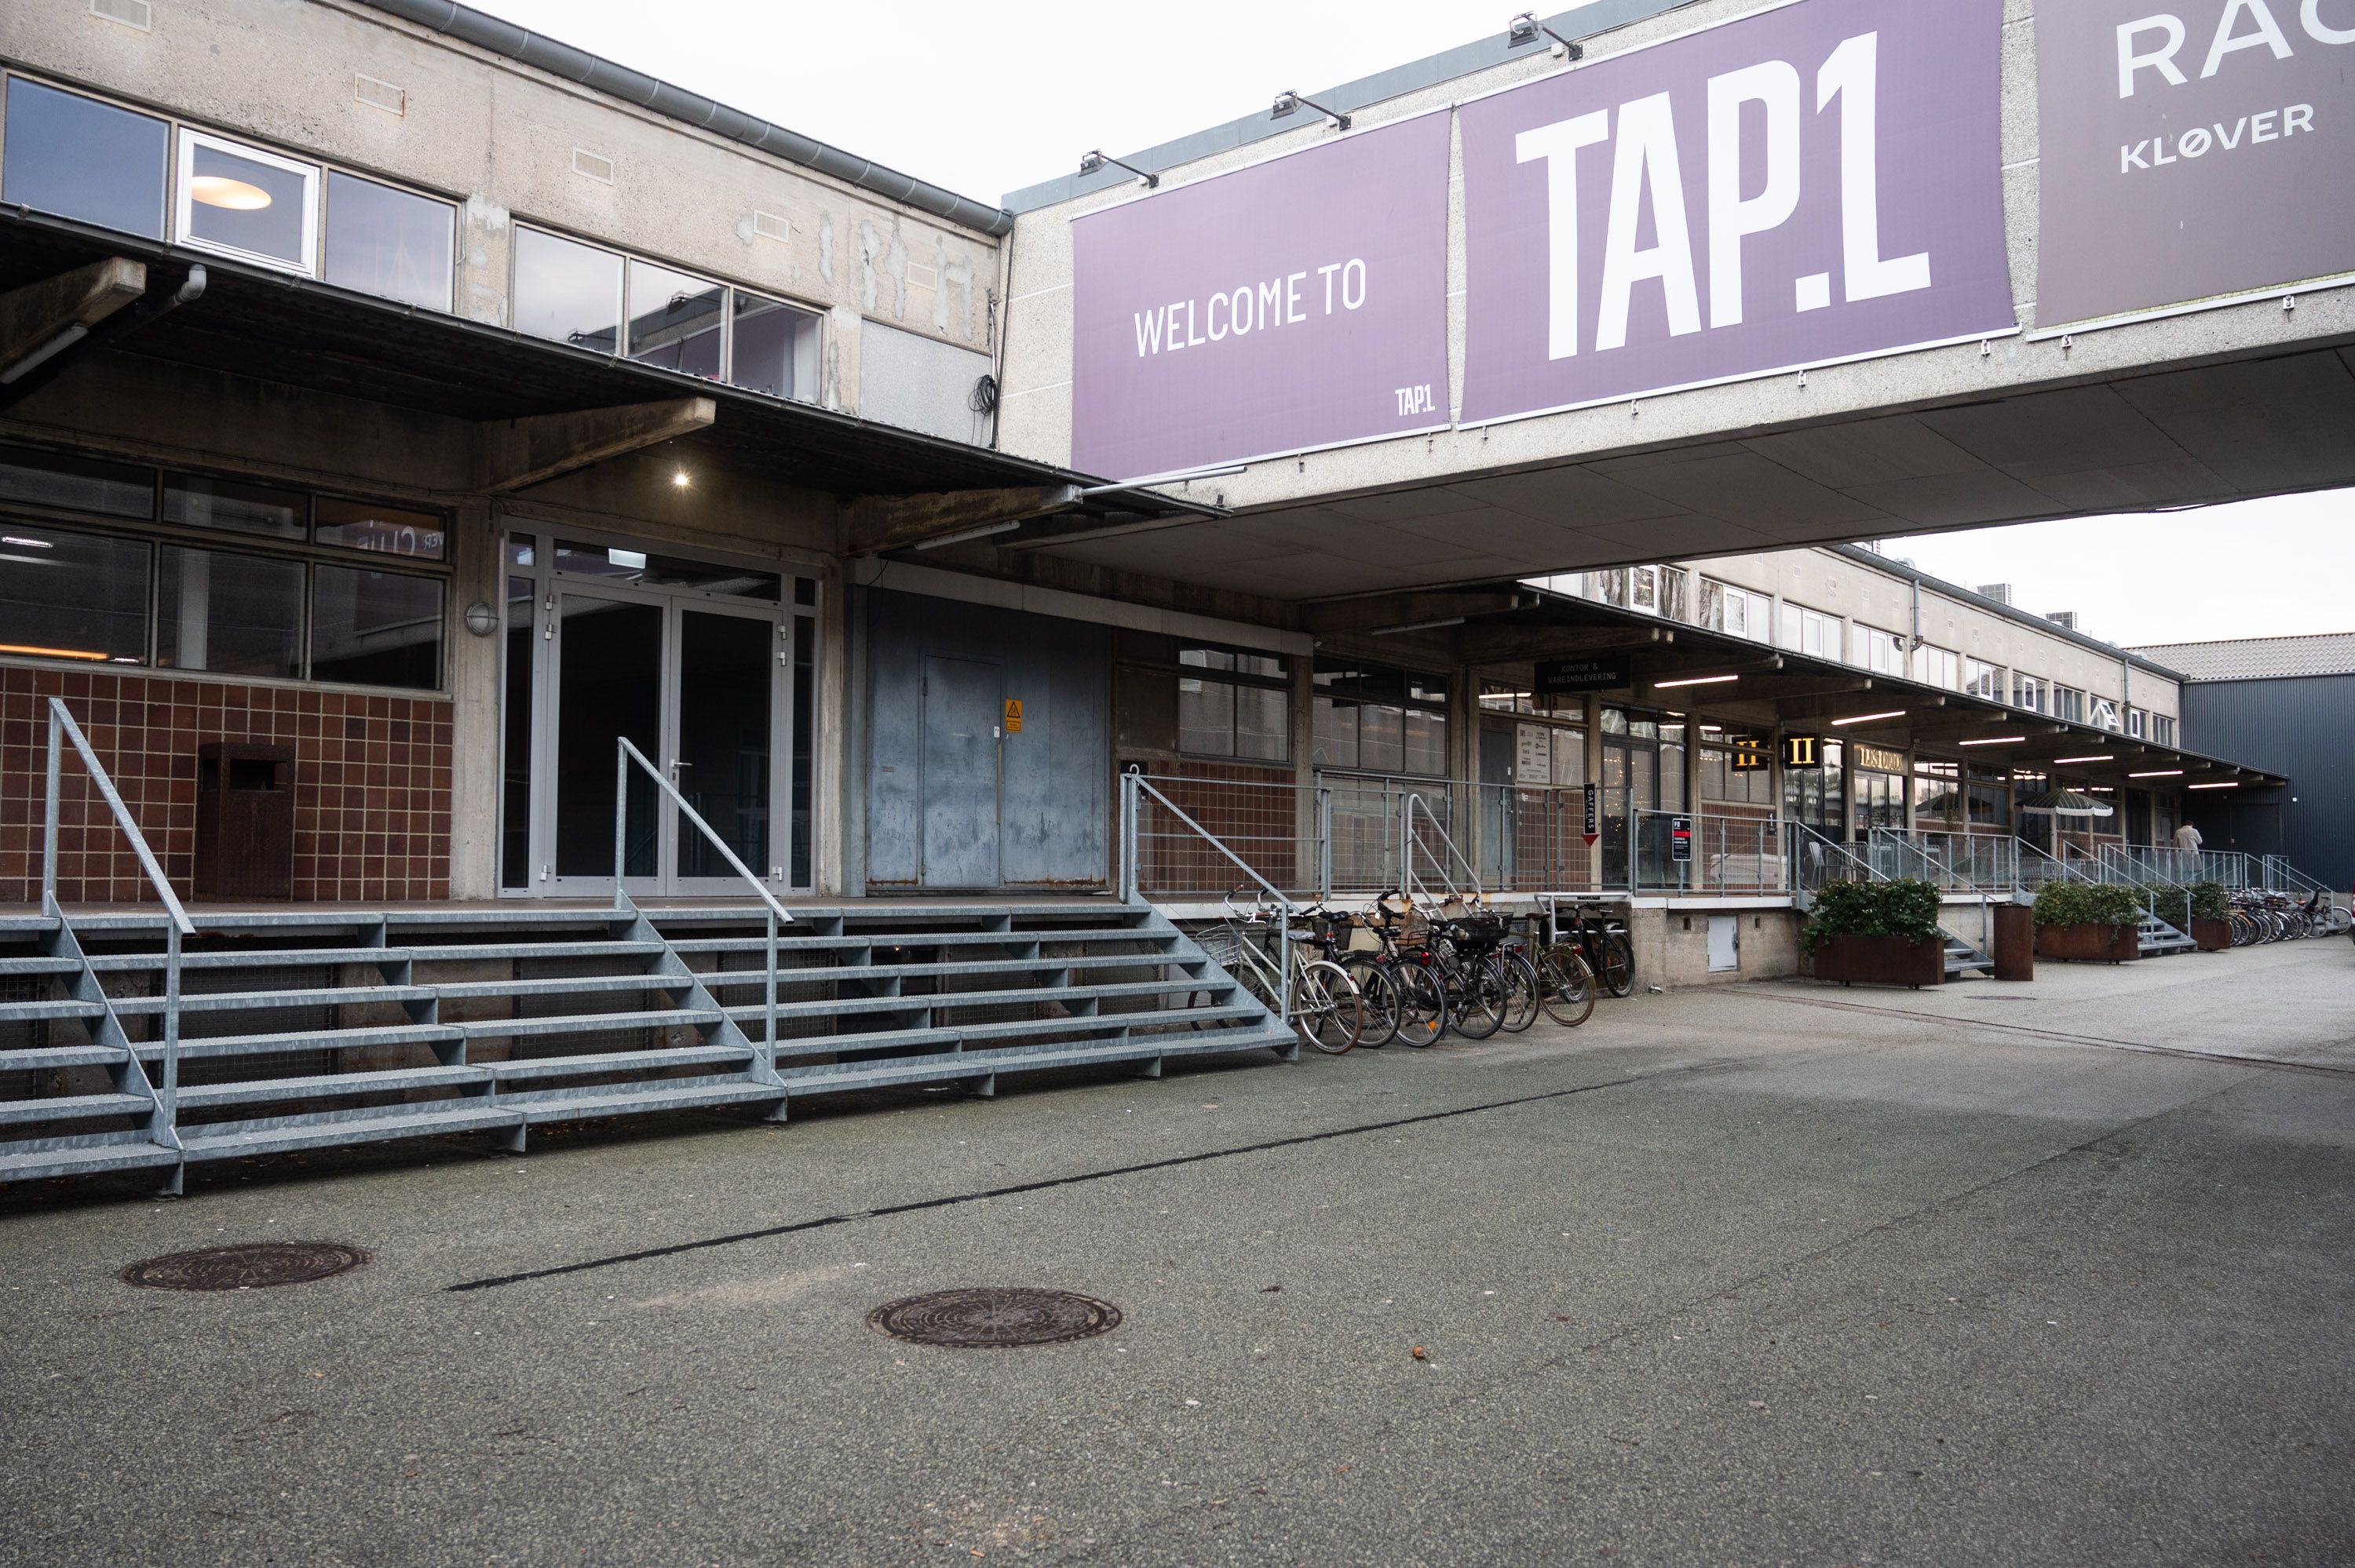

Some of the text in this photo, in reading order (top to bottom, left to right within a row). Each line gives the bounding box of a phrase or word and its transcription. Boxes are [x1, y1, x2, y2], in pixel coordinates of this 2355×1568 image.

[2120, 103, 2314, 174] KLØVER
[1515, 31, 1931, 361] TAP.1
[1134, 257, 1367, 358] WELCOME TO
[1547, 672, 1617, 684] VAREINDLEVERING
[1561, 662, 1598, 673] KONTOR &
